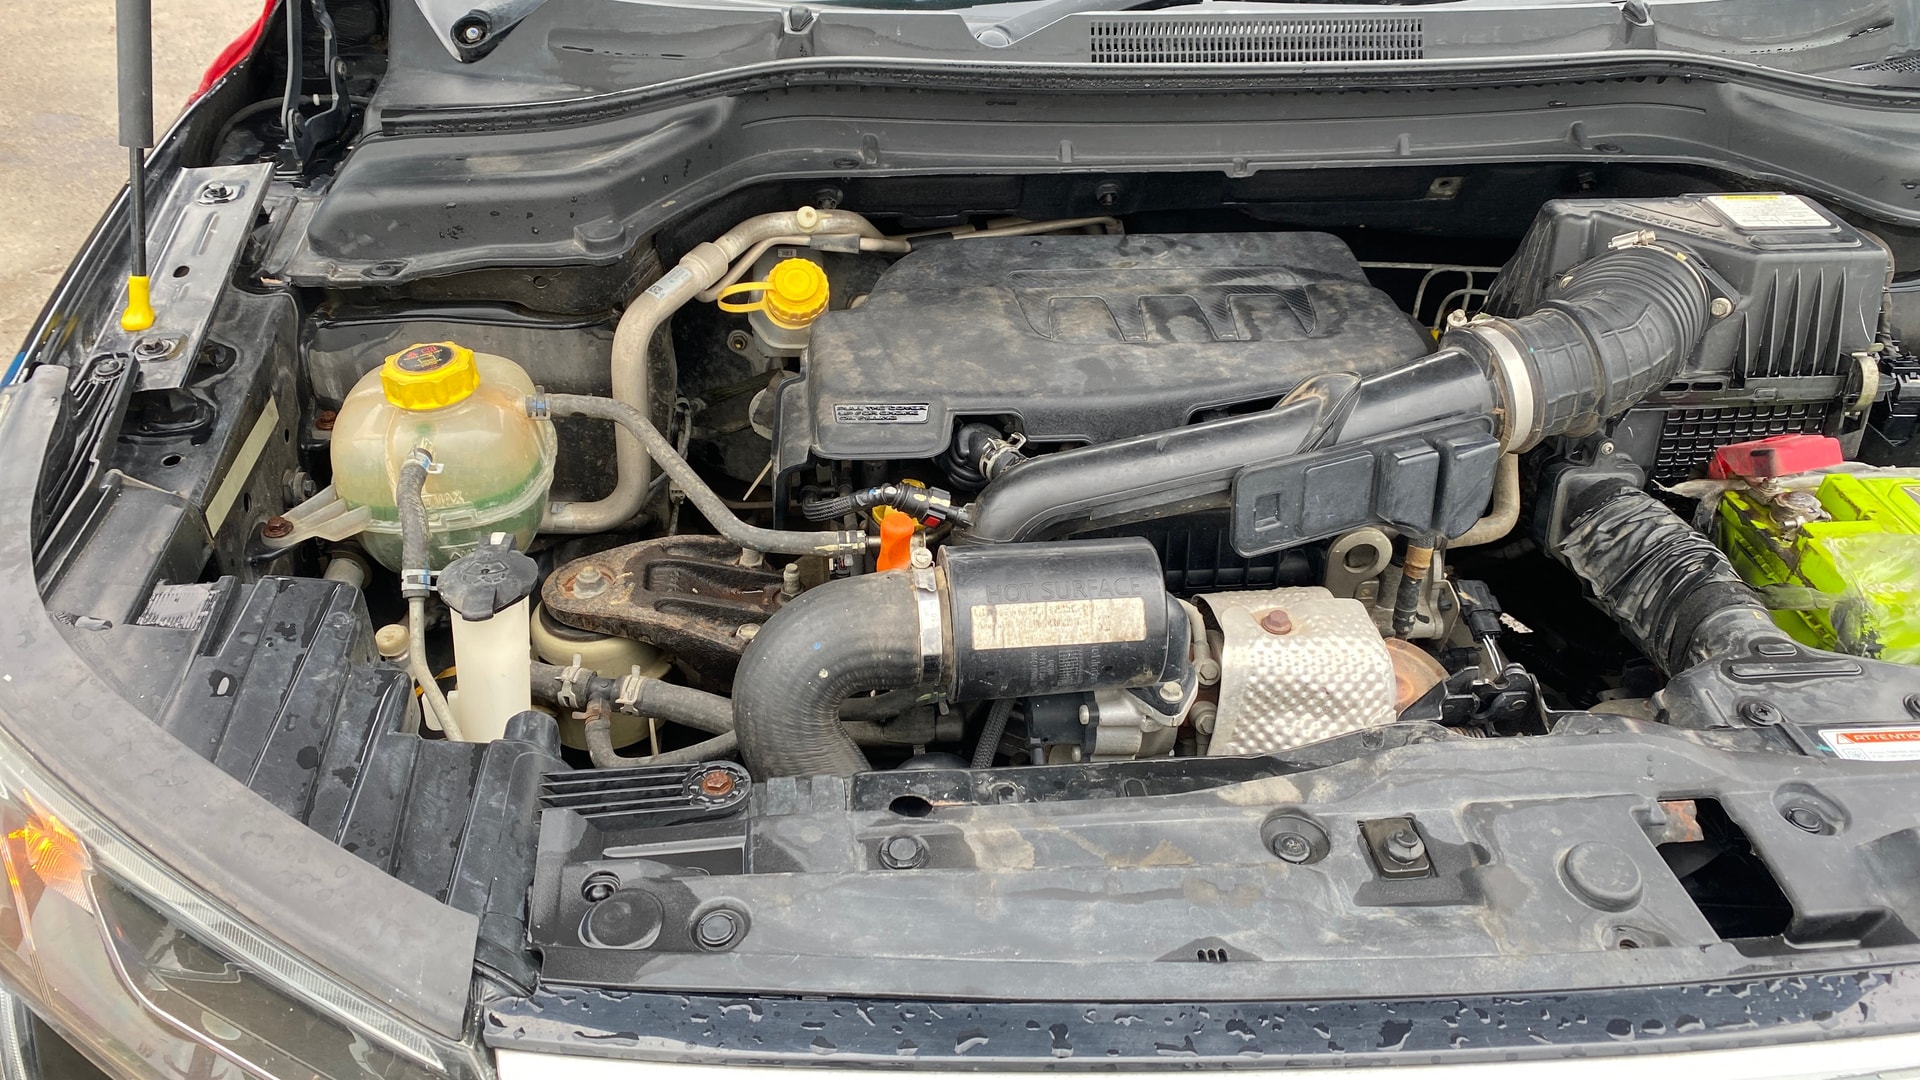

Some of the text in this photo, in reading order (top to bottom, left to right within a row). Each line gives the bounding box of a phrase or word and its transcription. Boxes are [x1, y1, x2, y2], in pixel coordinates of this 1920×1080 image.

[431, 489, 465, 507] MAX
[985, 576, 1143, 604] HOT SURFACE
